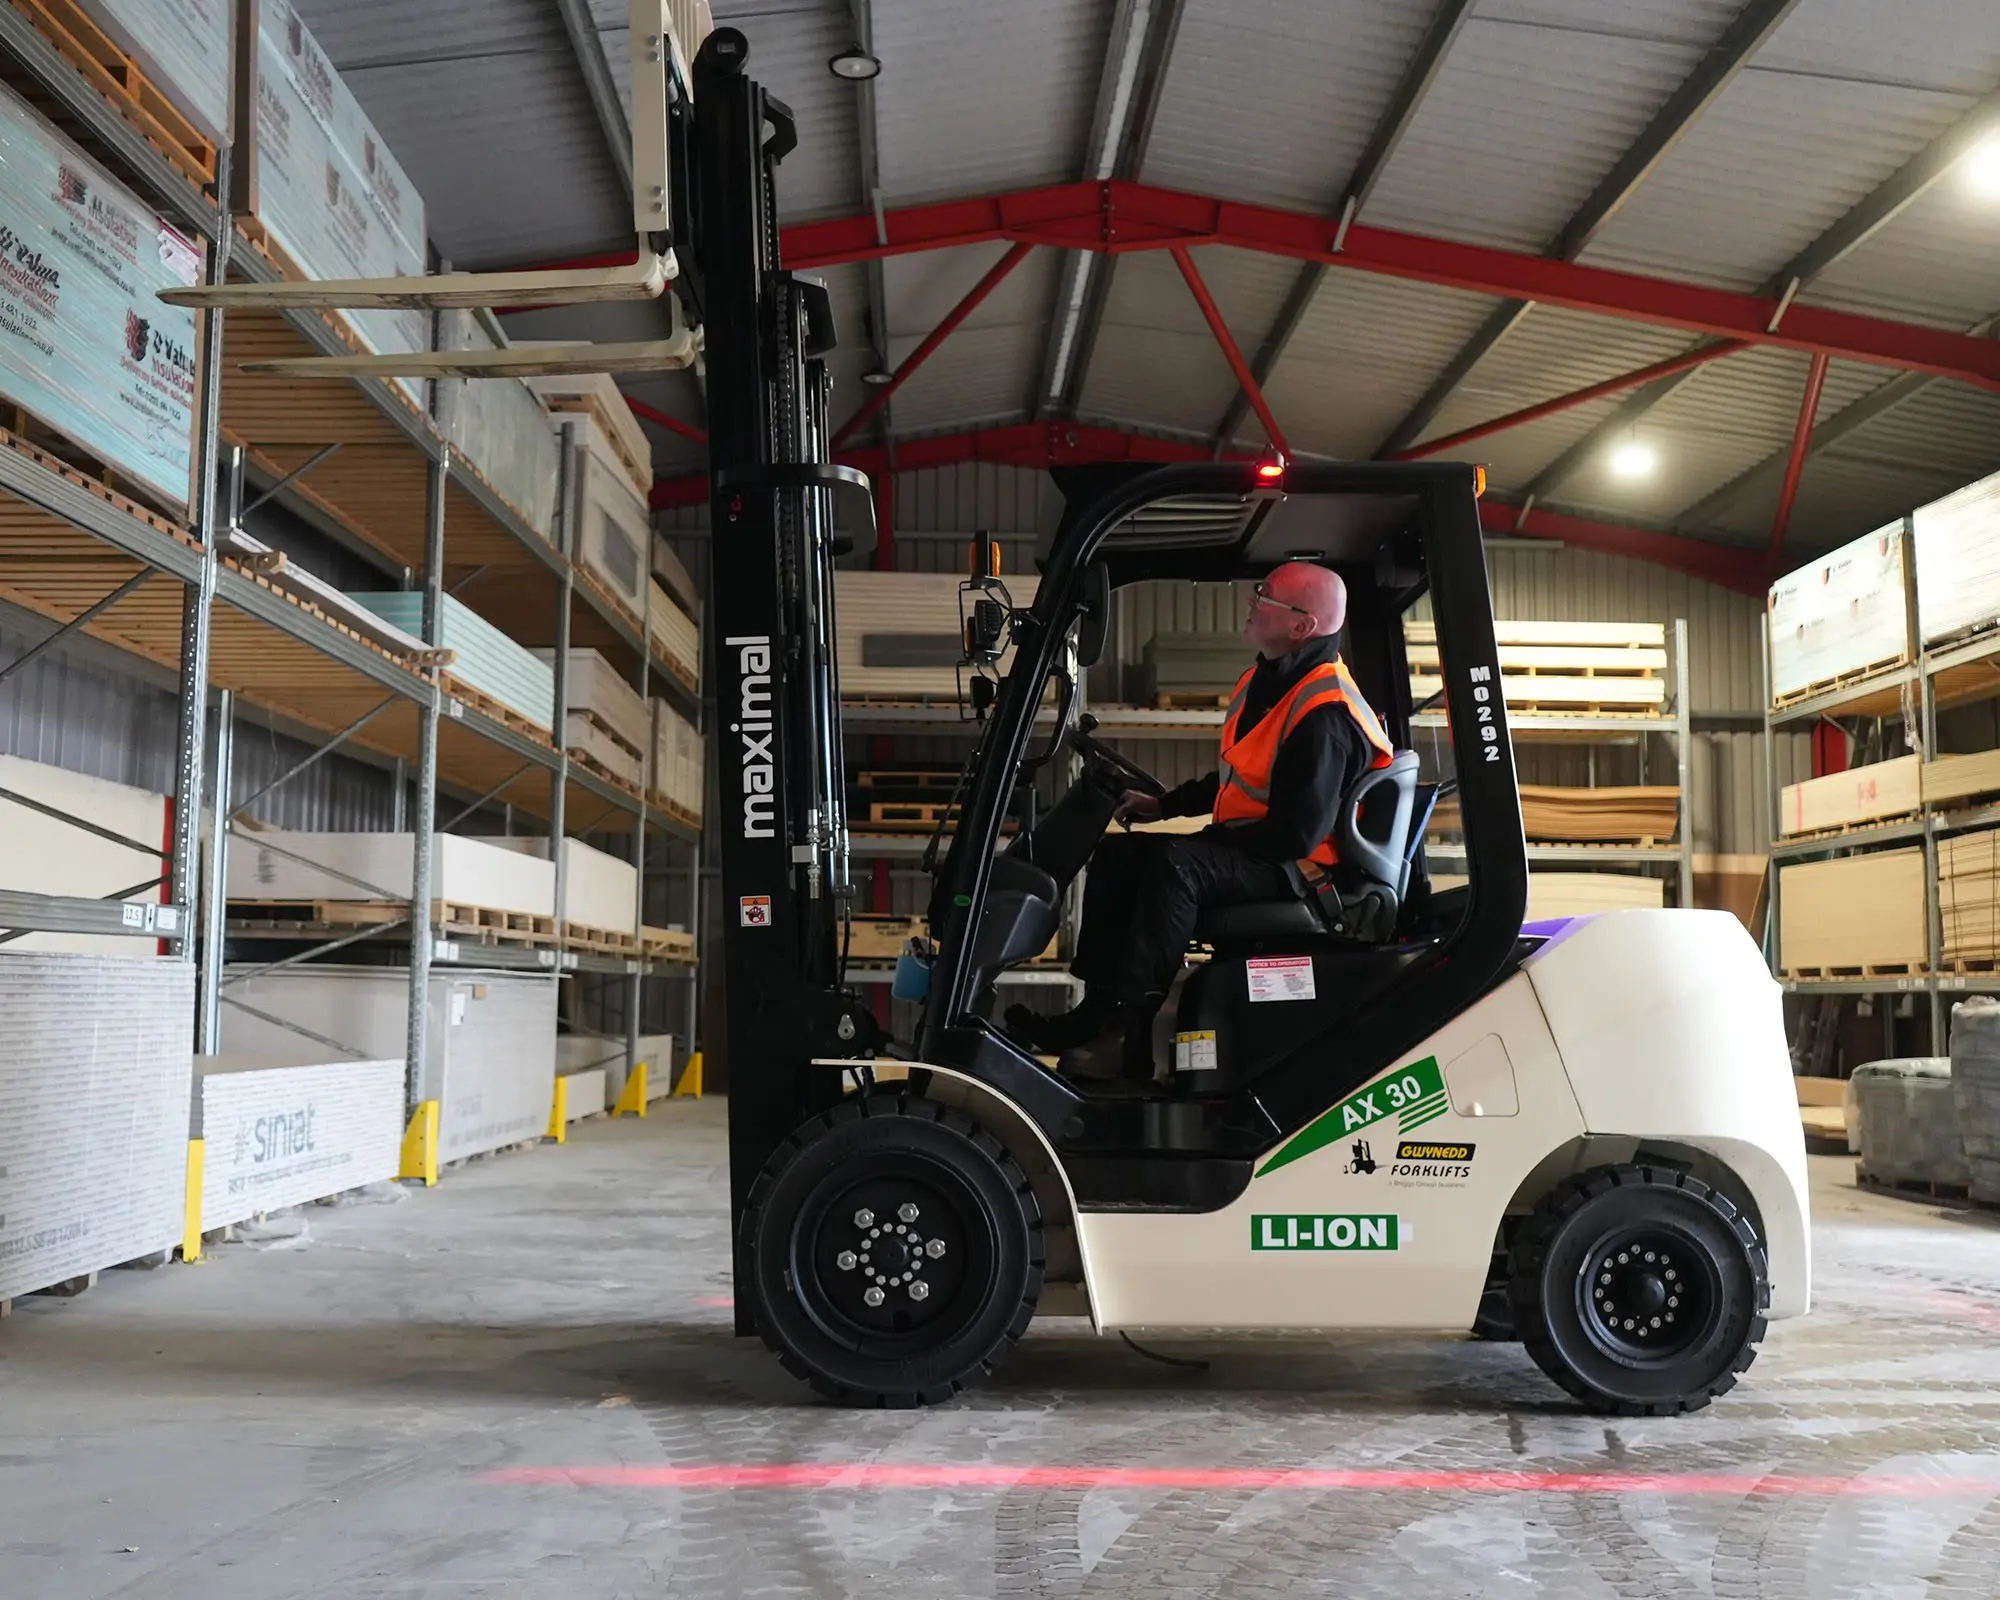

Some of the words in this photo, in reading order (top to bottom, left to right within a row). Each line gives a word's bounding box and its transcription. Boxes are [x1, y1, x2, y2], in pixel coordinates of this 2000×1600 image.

[726, 636, 775, 838] maximal
[1469, 666, 1500, 762] M0292
[1342, 1093, 1384, 1131] AX
[1385, 1075, 1421, 1108] 30
[253, 1102, 317, 1163] siniat
[1401, 1145, 1468, 1159] GWYNEDD
[1391, 1165, 1471, 1178] FORKLIFTS
[1262, 1217, 1387, 1247] LI-ION
